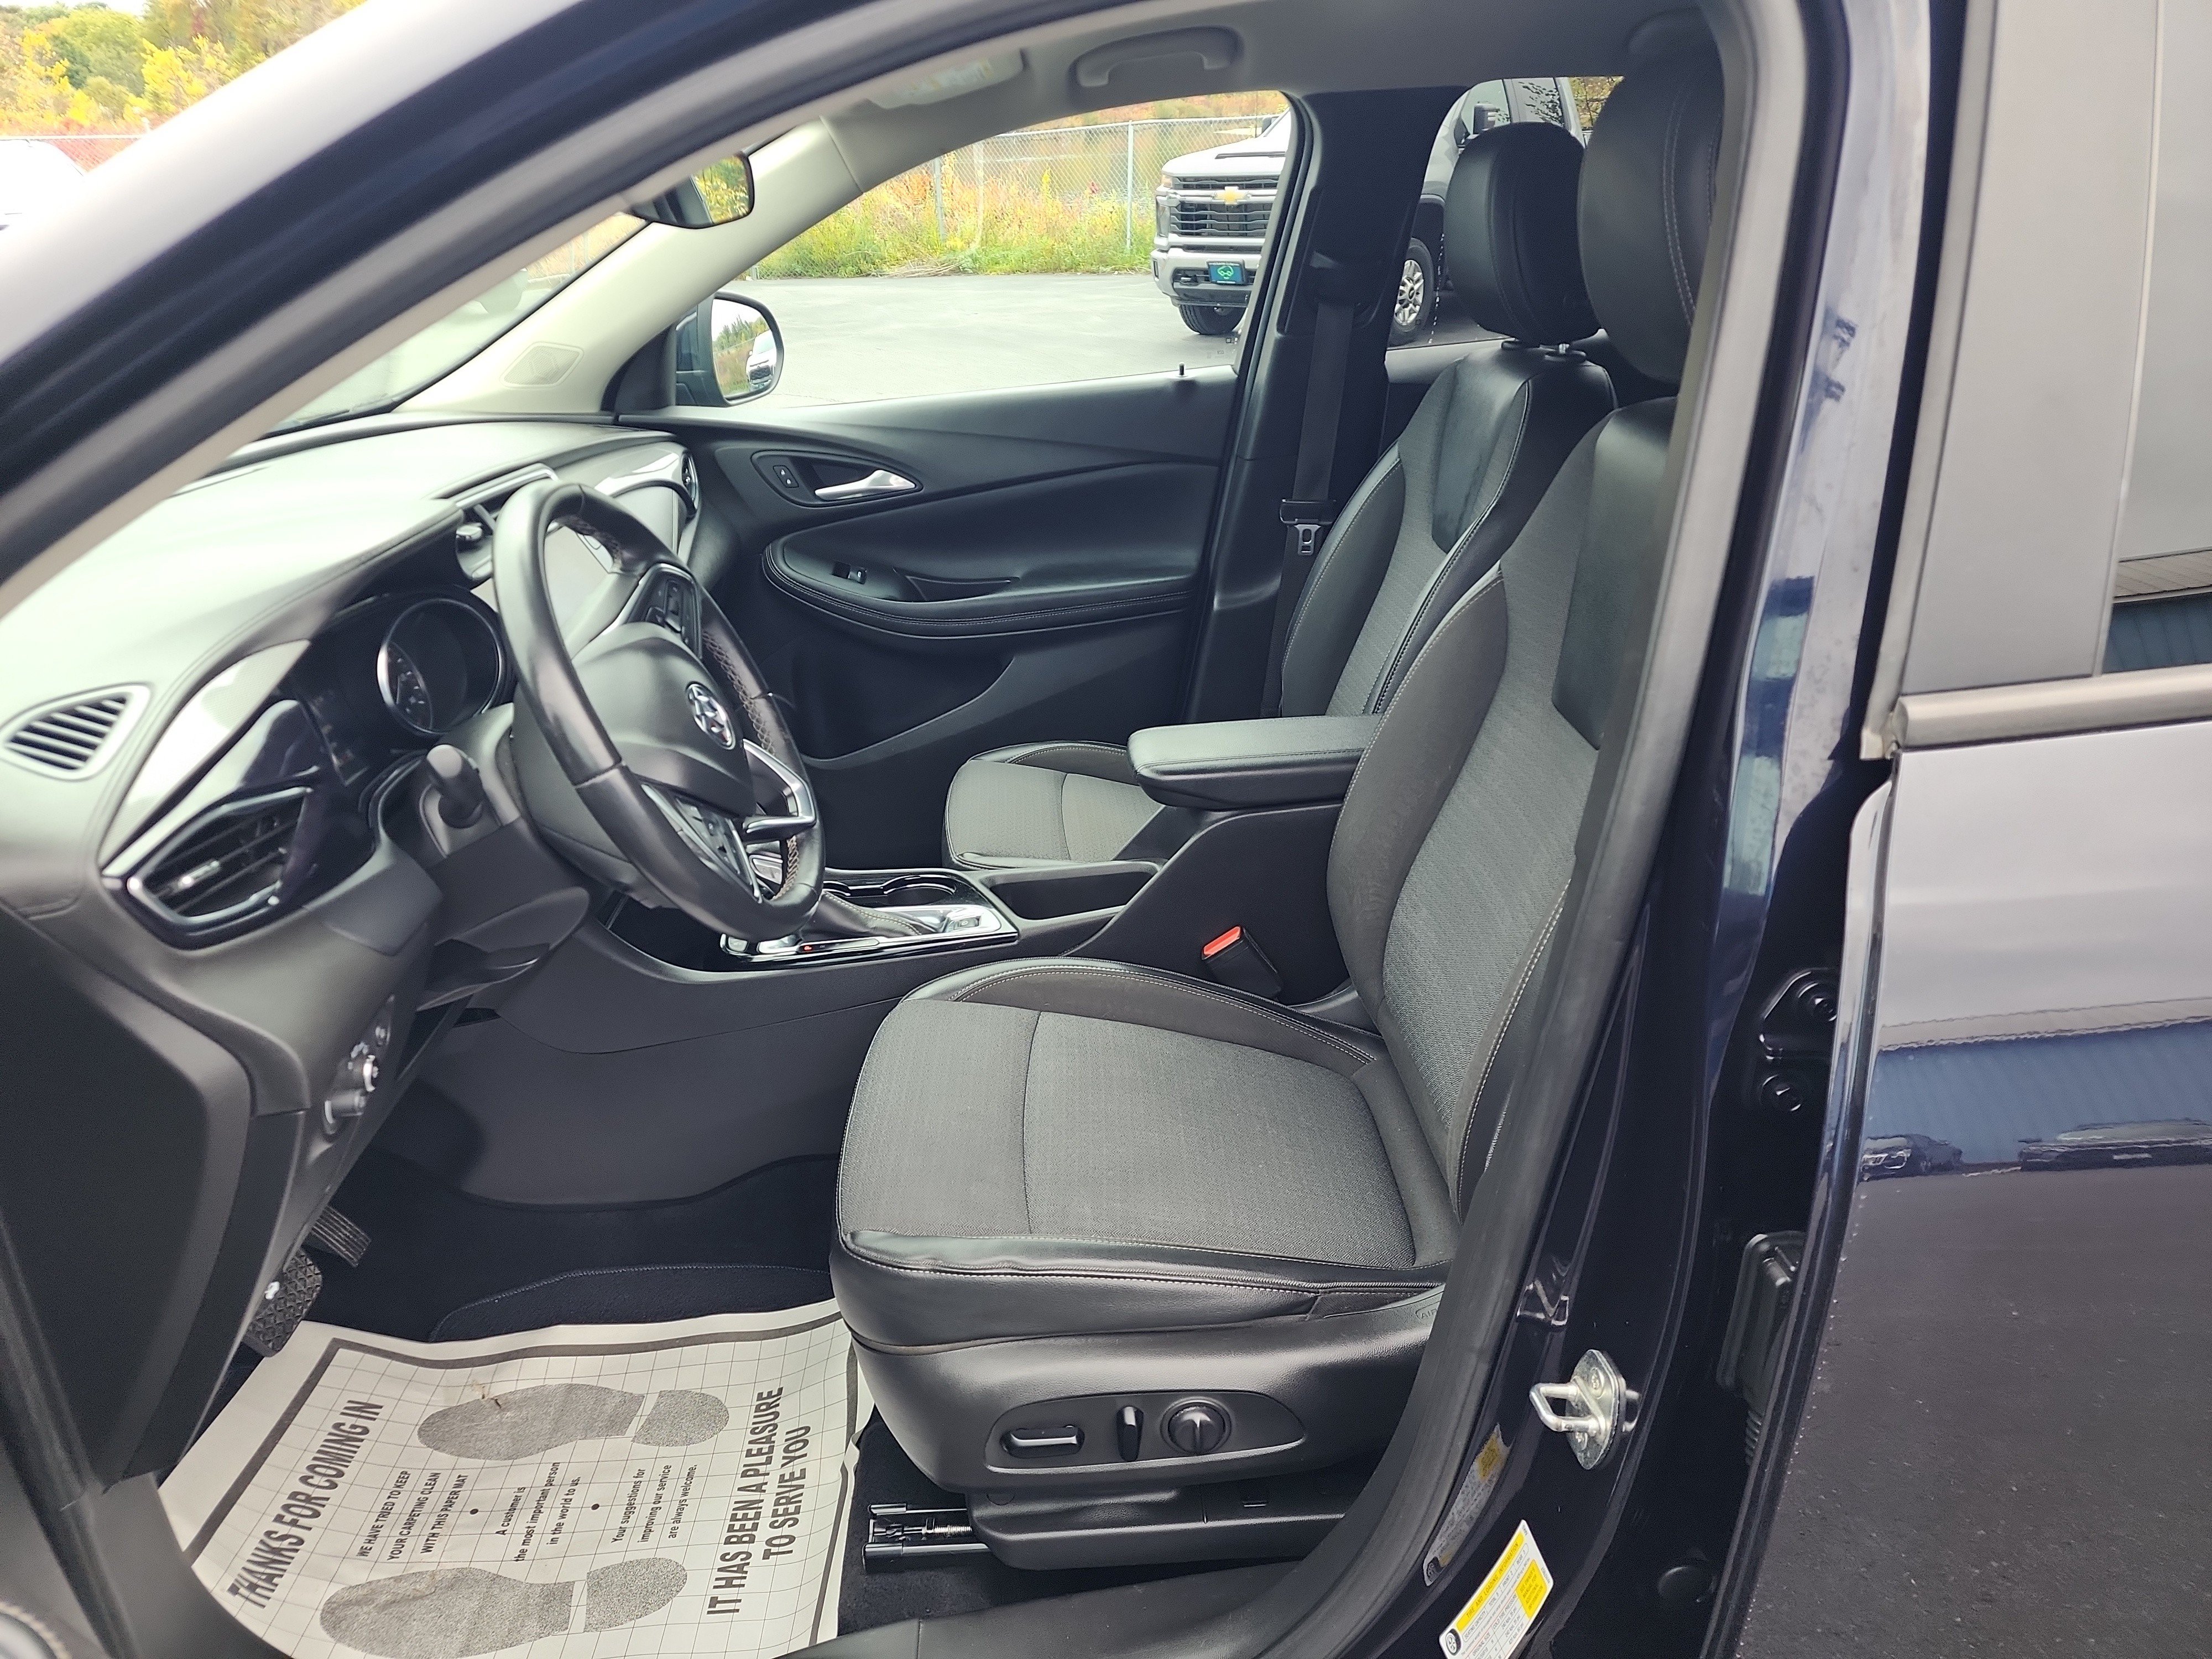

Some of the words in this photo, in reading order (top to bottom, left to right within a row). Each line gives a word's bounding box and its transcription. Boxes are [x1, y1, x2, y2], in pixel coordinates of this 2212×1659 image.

[339, 1400, 384, 1421] IN
[740, 1386, 783, 1478] PLEASURE
[299, 1422, 370, 1490] COMING
[780, 1425, 811, 1468] YOU
[393, 1470, 411, 1489] KEEP
[544, 1462, 560, 1487] person
[570, 1477, 581, 1486] us.
[657, 1465, 672, 1491] service
[680, 1464, 697, 1498] welcome.
[737, 1481, 769, 1493] A
[387, 1490, 401, 1499] TO
[564, 1488, 576, 1496] to
[653, 1493, 664, 1505] our
[768, 1467, 807, 1530] SERVE
[272, 1491, 330, 1531] FOR
[375, 1501, 395, 1523] TRIED
[387, 1538, 408, 1561] YOUR
[399, 1496, 429, 1536] CARPETING
[420, 1472, 441, 1495] CLEAN
[420, 1532, 440, 1553] WITH
[431, 1513, 449, 1530] THIS
[440, 1490, 461, 1512] PAPER
[452, 1474, 469, 1489] MAT
[501, 1495, 523, 1527] customer
[526, 1488, 551, 1524] important
[557, 1498, 573, 1520] world
[611, 1526, 628, 1543] Your
[620, 1480, 643, 1524] suggestions
[633, 1468, 646, 1479] for
[671, 1499, 688, 1524] always
[363, 1525, 383, 1544] HAVE
[551, 1522, 564, 1535] the
[637, 1506, 662, 1543] improving
[668, 1526, 679, 1538] are
[723, 1499, 764, 1546] BEEN
[521, 1525, 536, 1546] most
[546, 1537, 559, 1545] in
[762, 1534, 796, 1560] TO
[356, 1546, 373, 1557] WE
[513, 1548, 528, 1562] the
[227, 1530, 305, 1609] THANKS
[712, 1551, 753, 1589] HAS
[1466, 1607, 1475, 1618] TIRE
[1475, 1595, 1484, 1608] AND
[1483, 1574, 1499, 1596] LOADING
[1498, 1541, 1519, 1575] INFORMATION
[706, 1596, 742, 1615] IT
